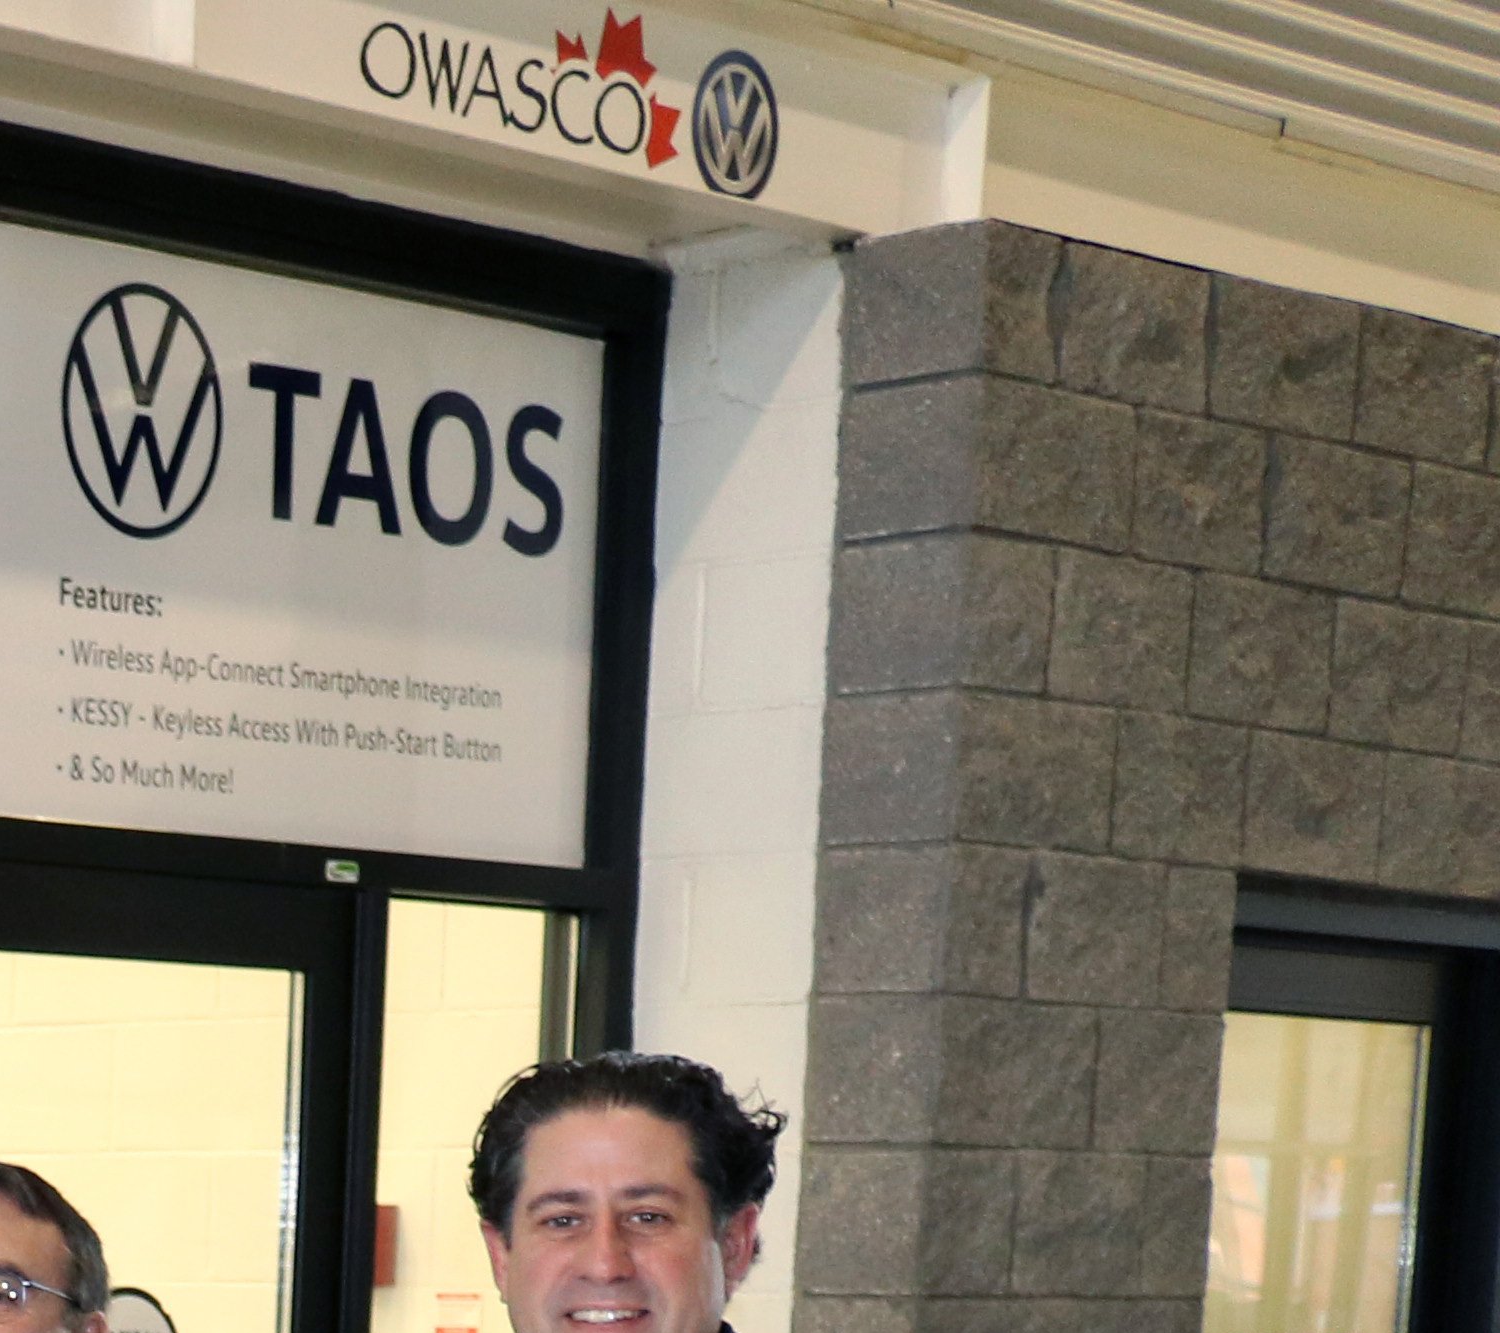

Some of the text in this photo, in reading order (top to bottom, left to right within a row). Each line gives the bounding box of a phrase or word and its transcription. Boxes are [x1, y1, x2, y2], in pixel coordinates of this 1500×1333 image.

[361, 21, 646, 157] OWASCO
[249, 363, 563, 557] TAOS
[59, 576, 162, 616] Features:
[71, 640, 502, 711] Wireless App-Connect Smartphone Integration
[71, 698, 131, 727] KESSY
[153, 706, 222, 739] Keyless
[228, 713, 290, 743] Access
[296, 720, 338, 746] With
[344, 723, 437, 756] Push-Start
[443, 732, 501, 762] Button
[71, 755, 233, 793] & So Much More!
